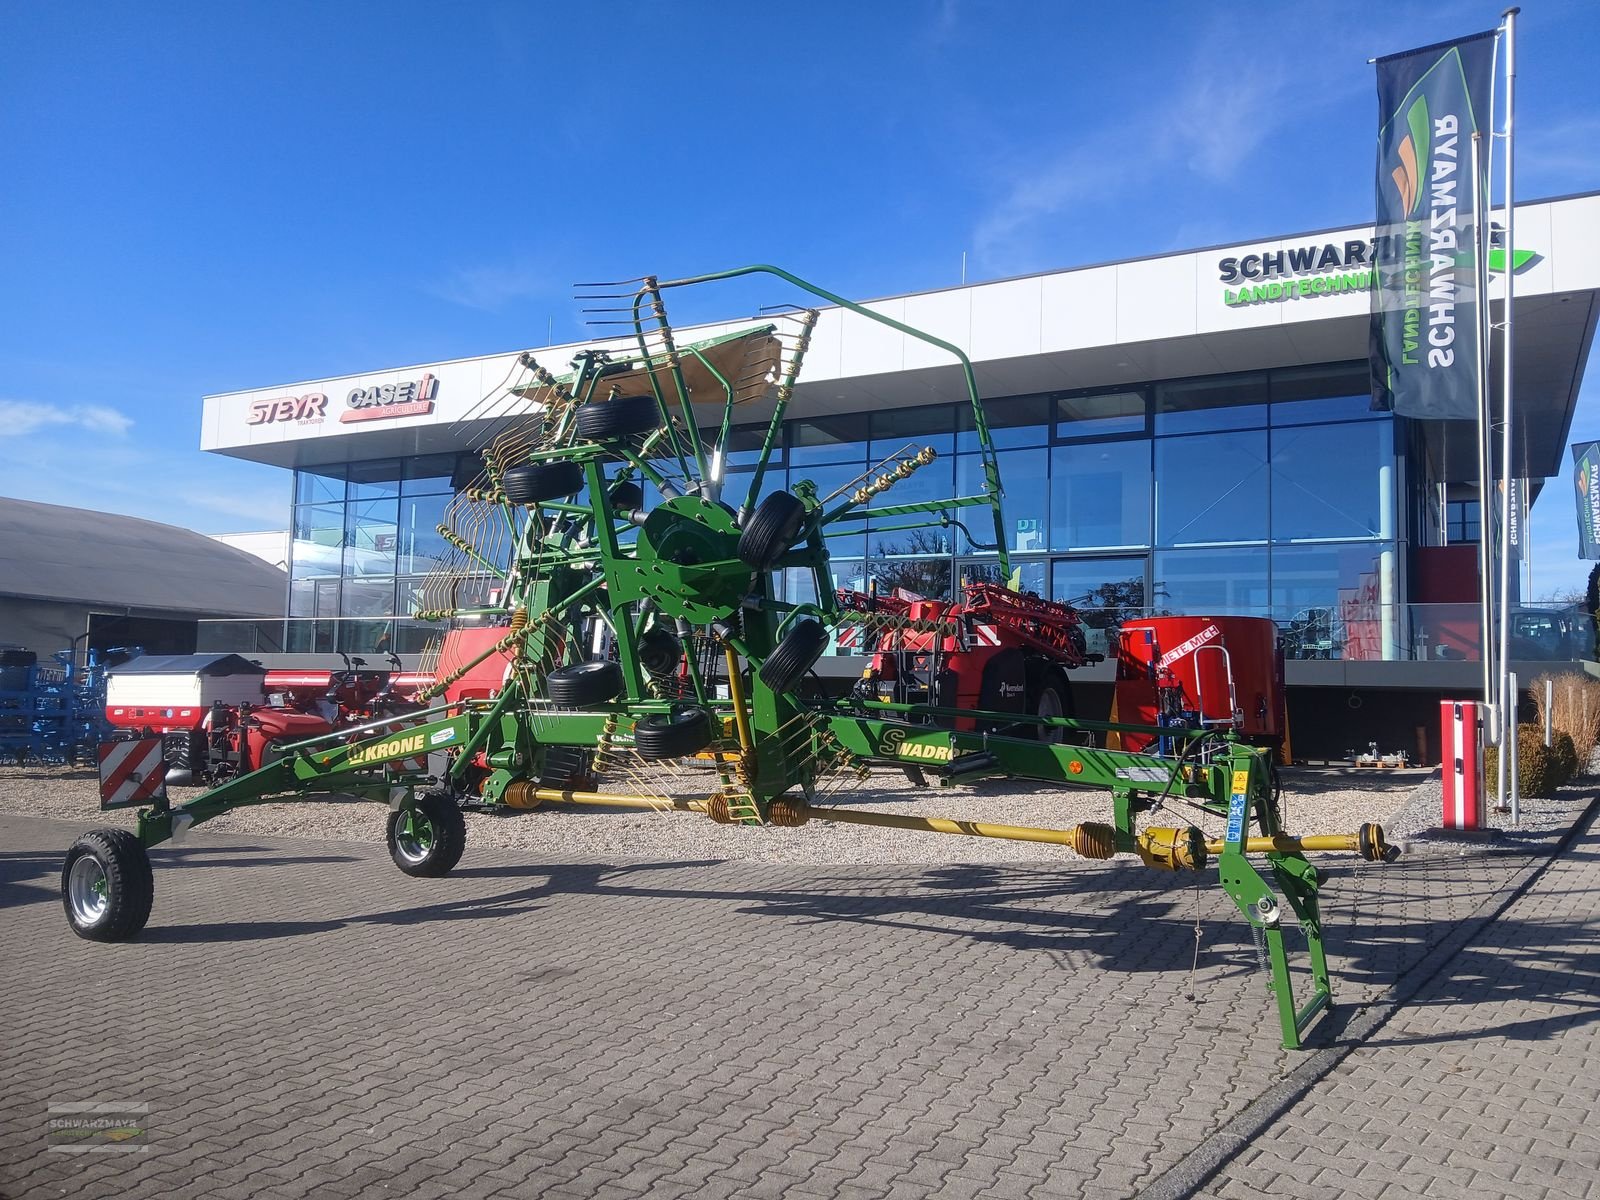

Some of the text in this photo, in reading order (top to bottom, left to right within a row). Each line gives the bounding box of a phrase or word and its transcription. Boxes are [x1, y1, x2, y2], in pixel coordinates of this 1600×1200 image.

[246, 392, 326, 424] STEYR
[381, 402, 428, 416] AGRICULTURE
[1188, 625, 1219, 648] MICH
[365, 734, 425, 762] KRONE
